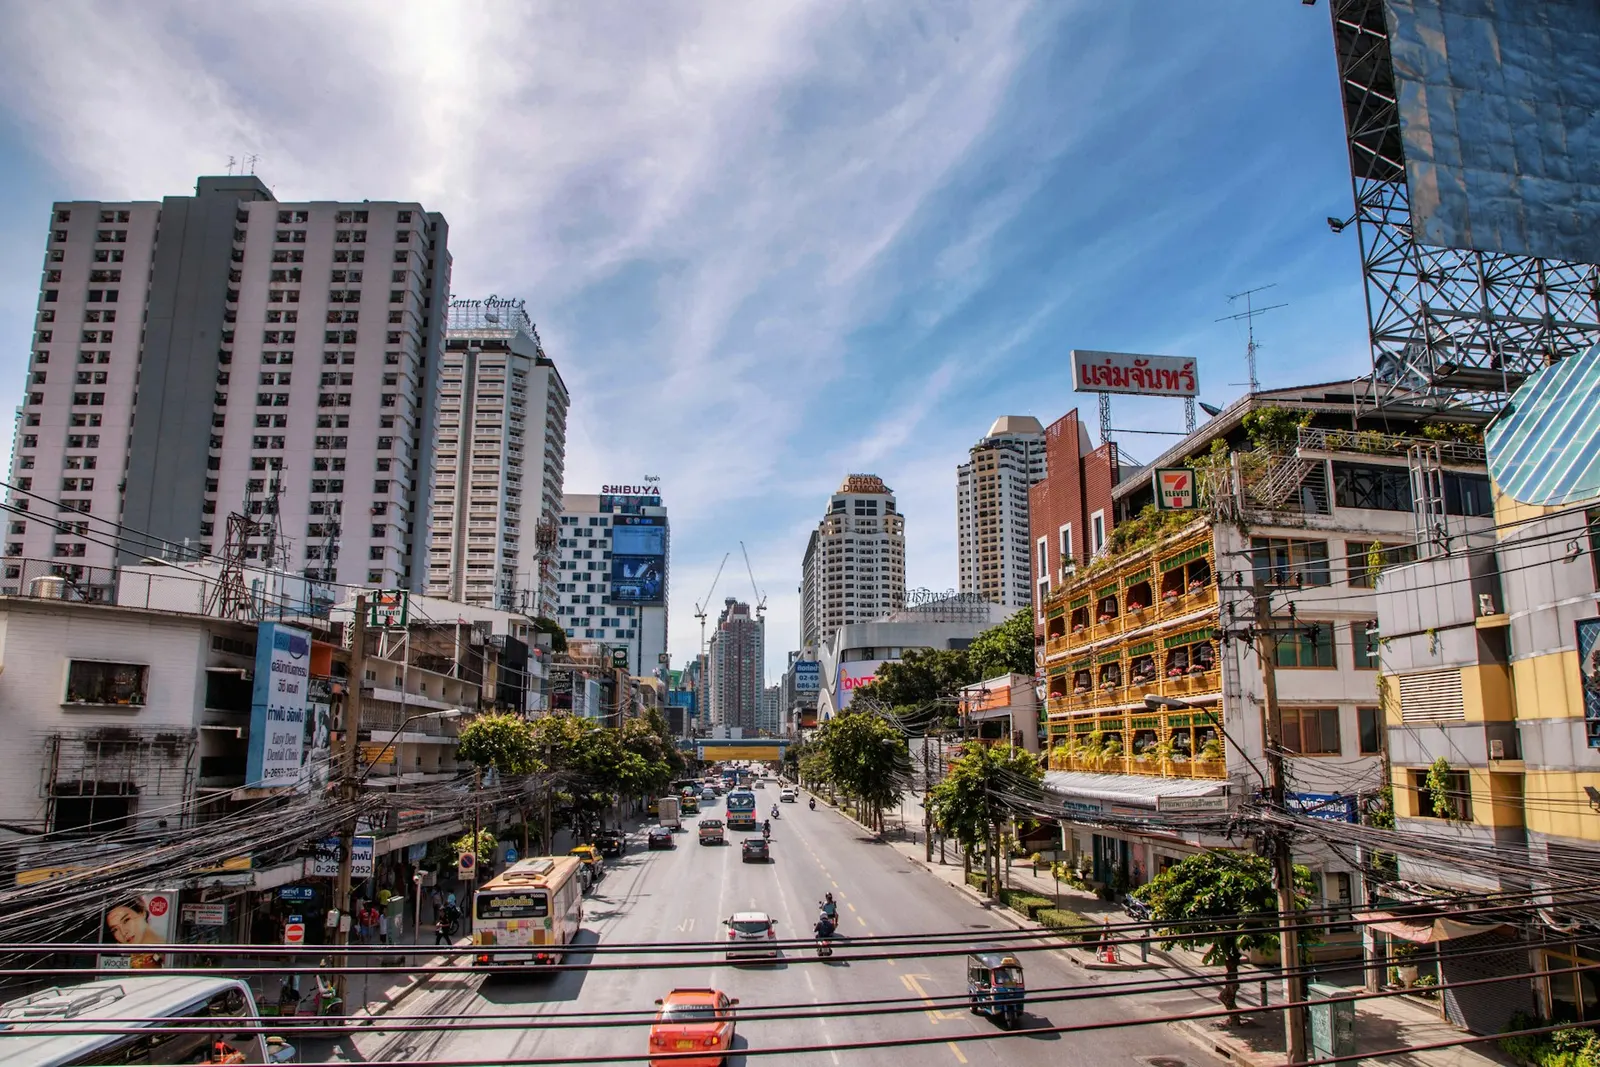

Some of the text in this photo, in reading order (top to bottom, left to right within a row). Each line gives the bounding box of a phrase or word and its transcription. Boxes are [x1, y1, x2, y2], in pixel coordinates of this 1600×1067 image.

[447, 294, 521, 308] Centre Point
[1081, 358, 1195, 391] แจ่มจันทร์
[848, 477, 883, 485] GRAND
[602, 485, 660, 495] SHIBUYA
[843, 485, 888, 493] DIAMOND
[268, 704, 304, 723] ทำฟัน จัดฟัน
[272, 732, 297, 747] Easy Dent
[267, 748, 299, 761] Dental Clinic
[315, 865, 371, 874] 0-2657952
[304, 889, 312, 897] 13
